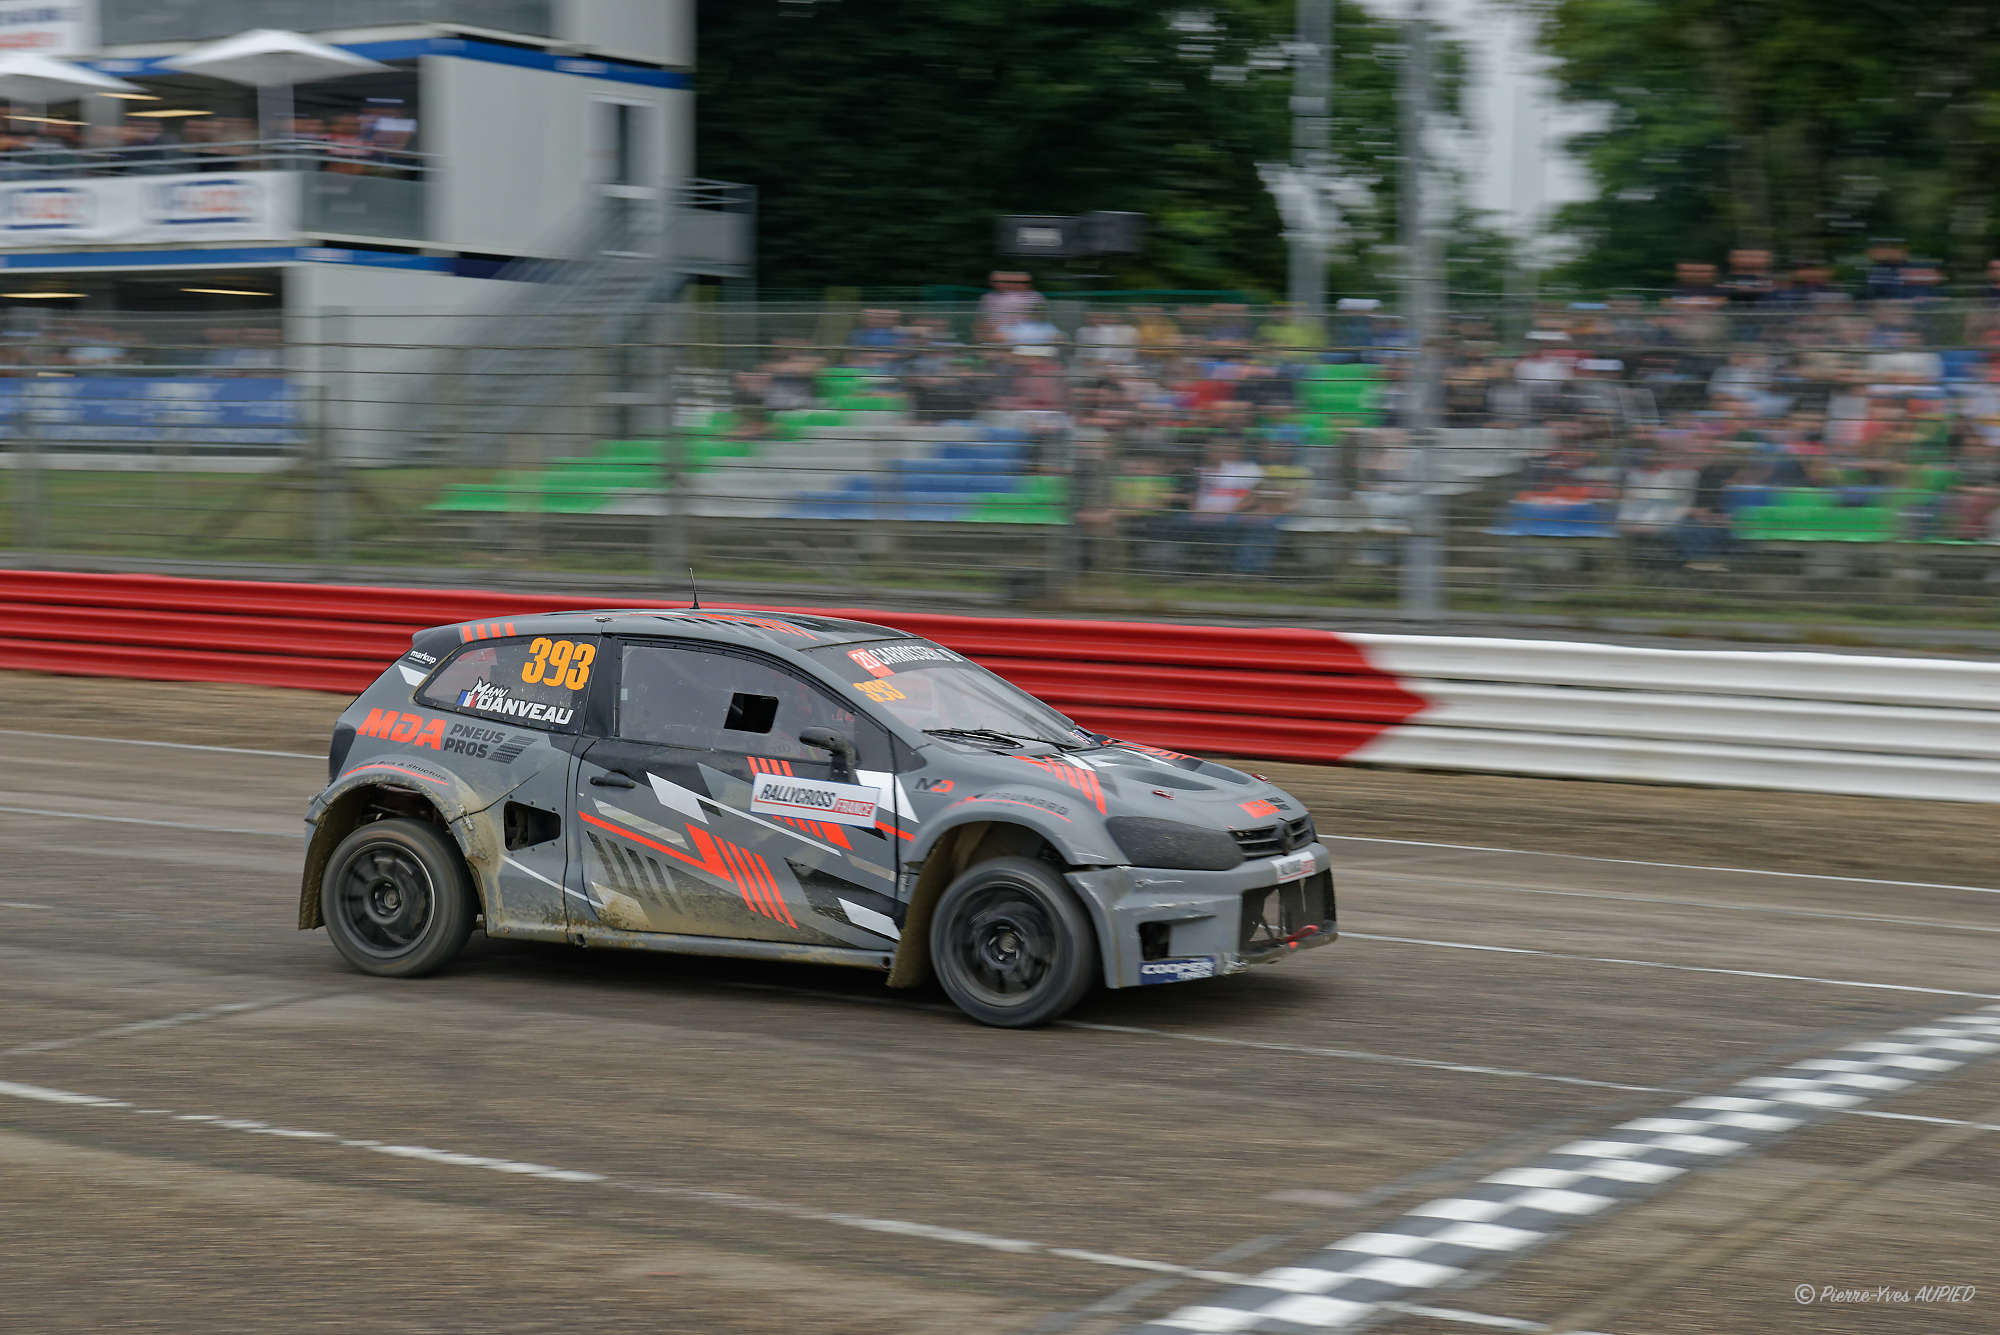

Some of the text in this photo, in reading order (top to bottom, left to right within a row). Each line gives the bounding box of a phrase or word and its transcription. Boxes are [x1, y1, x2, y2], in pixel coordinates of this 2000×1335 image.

[410, 650, 437, 665] markup
[521, 637, 596, 690] 393
[852, 679, 907, 703] 393
[476, 696, 574, 725] DANVEAU
[357, 707, 447, 750] MDA
[450, 723, 506, 744] PNEUS
[444, 738, 489, 759] PROS
[760, 783, 874, 816] RALLYCROSS FRANCE
[1140, 961, 1213, 975] COOPER
